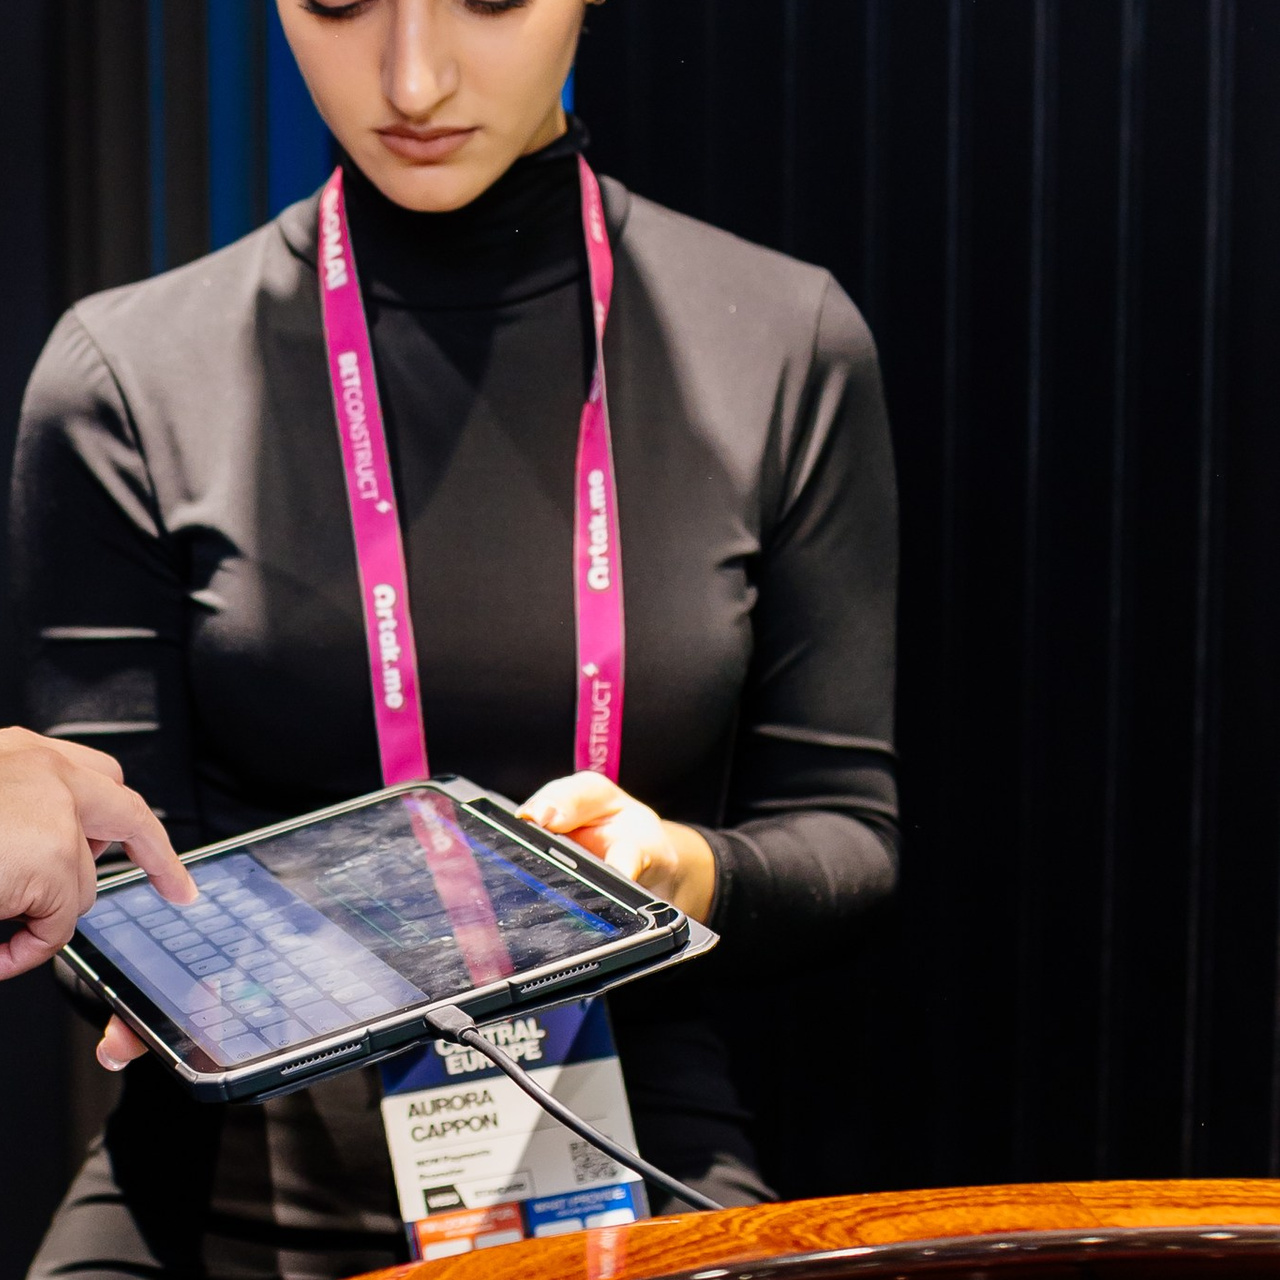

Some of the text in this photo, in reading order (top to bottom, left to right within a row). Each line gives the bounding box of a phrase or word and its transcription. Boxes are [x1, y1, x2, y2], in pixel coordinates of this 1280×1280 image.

[588, 680, 612, 772] NSTRUCT
[408, 1089, 494, 1120] AURORA
[411, 1112, 499, 1142] CAPPON
